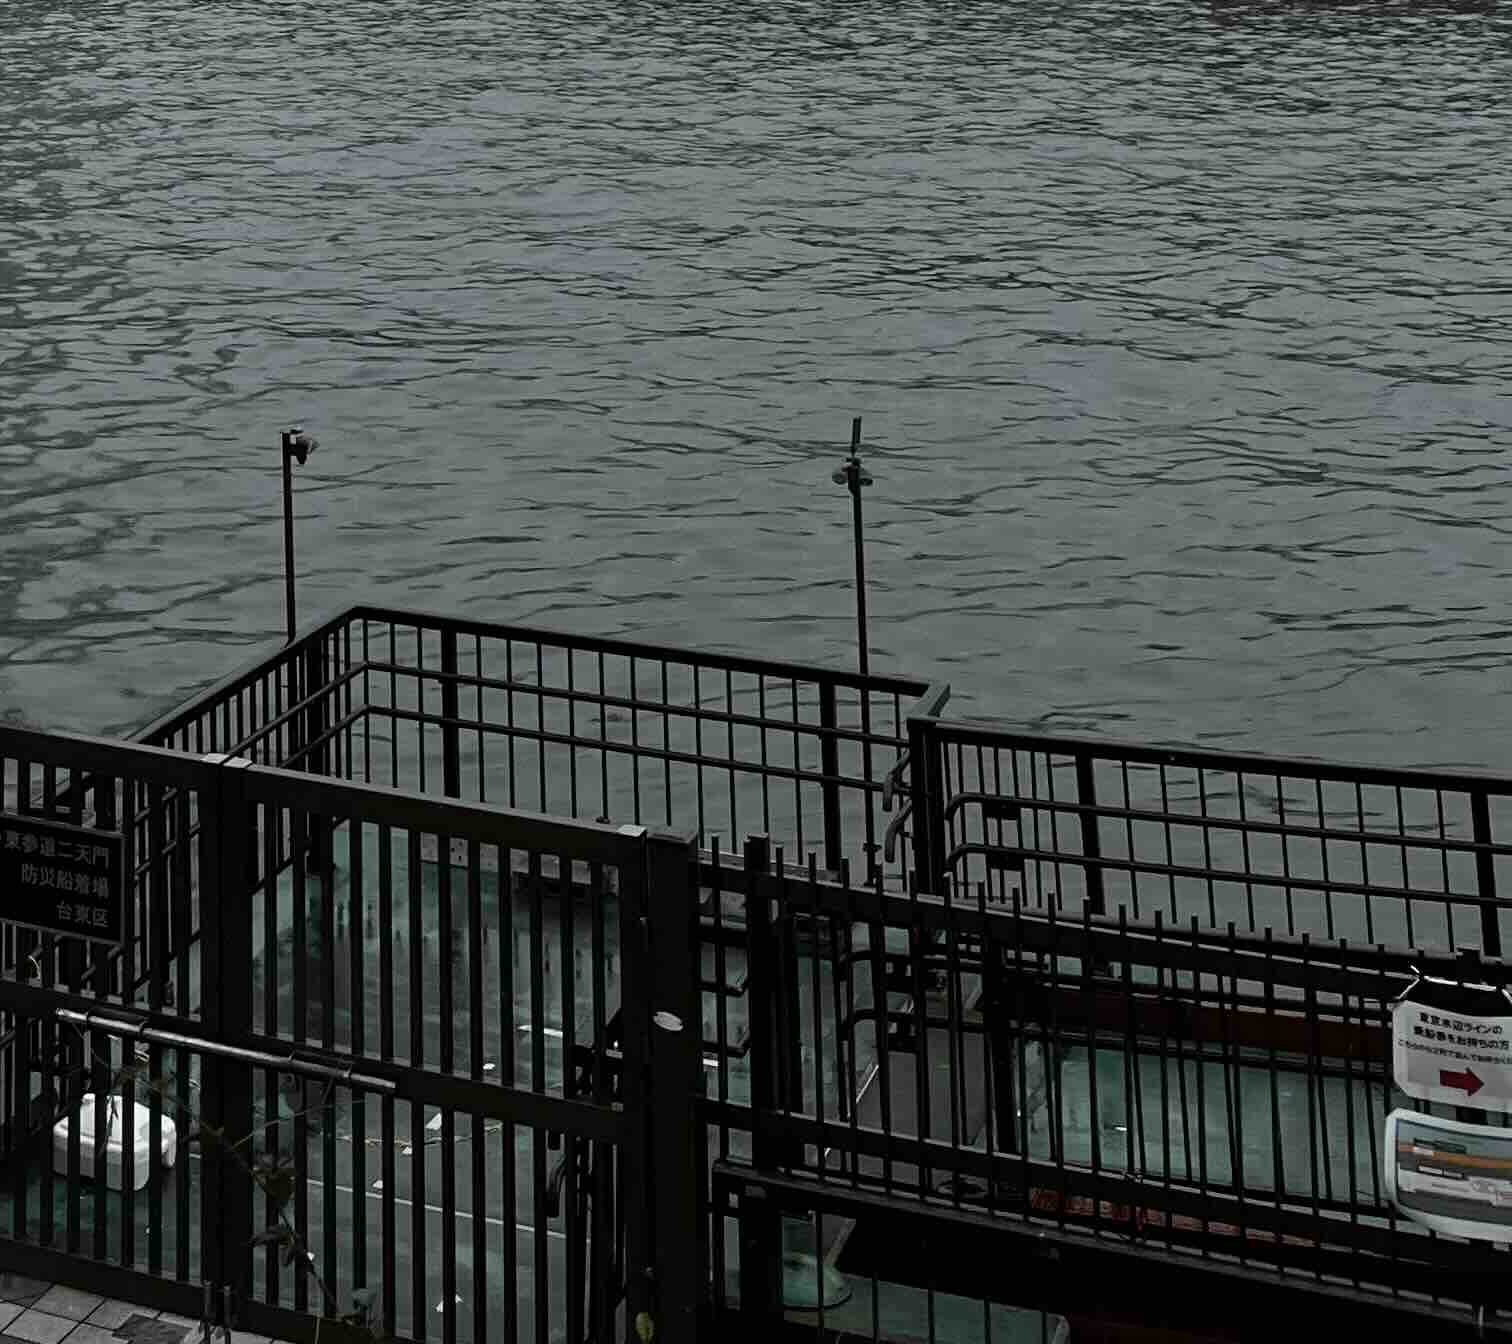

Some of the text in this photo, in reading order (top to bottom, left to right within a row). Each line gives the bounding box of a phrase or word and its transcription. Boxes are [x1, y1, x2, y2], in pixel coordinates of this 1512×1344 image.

[21, 862, 110, 900] 防災船着場
[56, 899, 110, 928] 台東区
